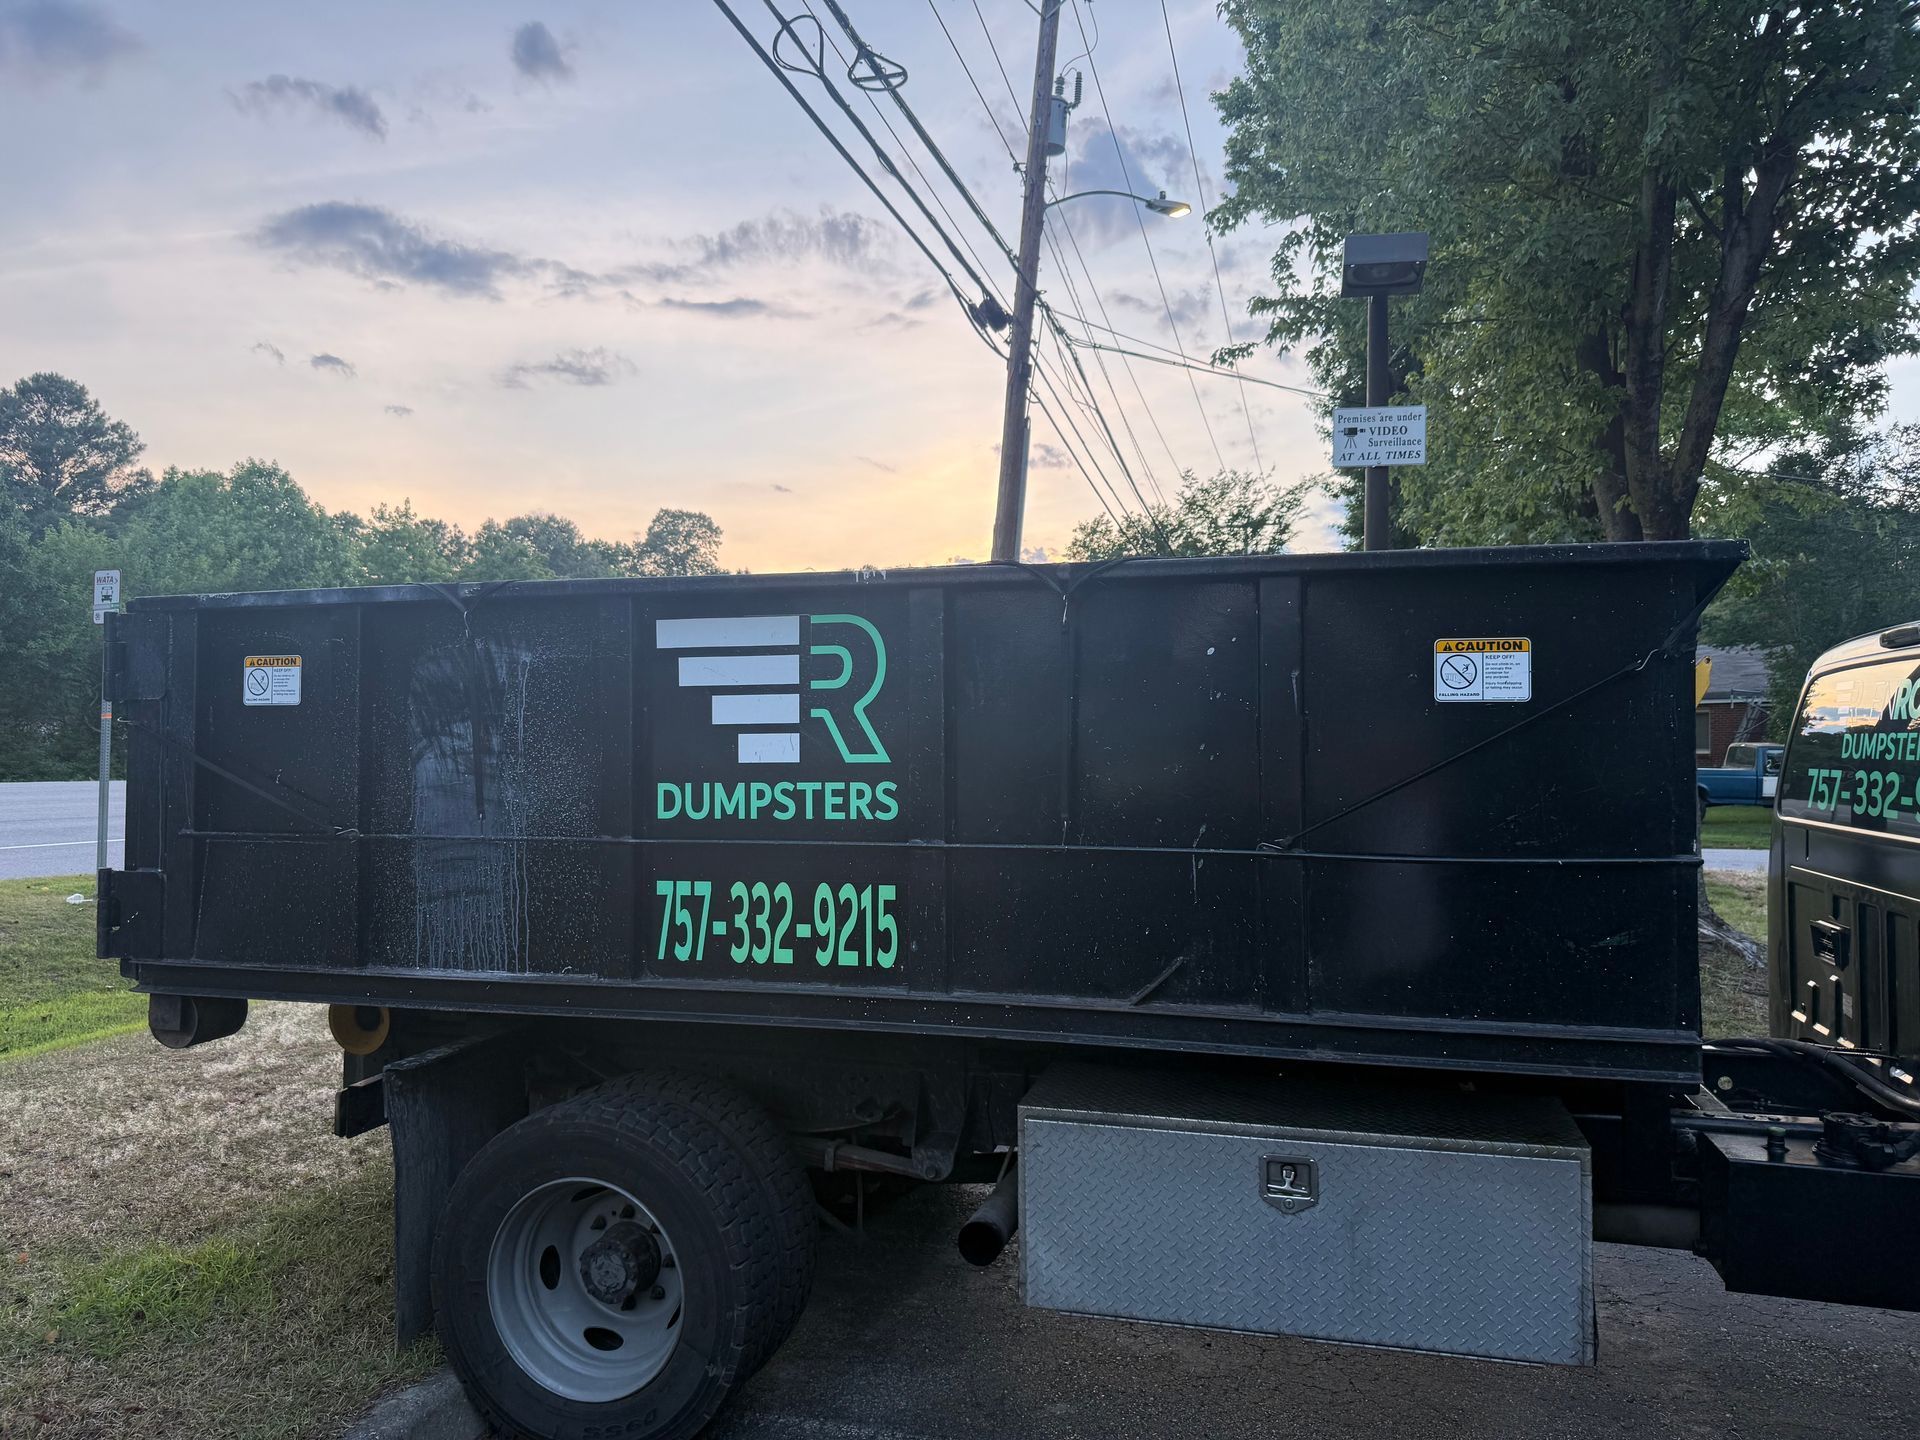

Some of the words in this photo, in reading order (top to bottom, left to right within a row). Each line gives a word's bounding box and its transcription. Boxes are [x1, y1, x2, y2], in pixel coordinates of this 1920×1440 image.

[1338, 414, 1375, 423] Premises
[1379, 414, 1393, 422] are
[1396, 412, 1422, 421] under
[1369, 426, 1408, 435] VIDEO
[1368, 438, 1422, 447] Surveillance
[1339, 453, 1354, 461] AT
[1358, 452, 1380, 460] ALL
[1386, 450, 1421, 460] TIMES
[96, 576, 114, 584] WATA
[1455, 641, 1523, 651] CAUTION
[256, 657, 297, 666] CAUTION
[656, 781, 899, 821] DUMPSTERS
[656, 880, 898, 968] 757-332-9215
